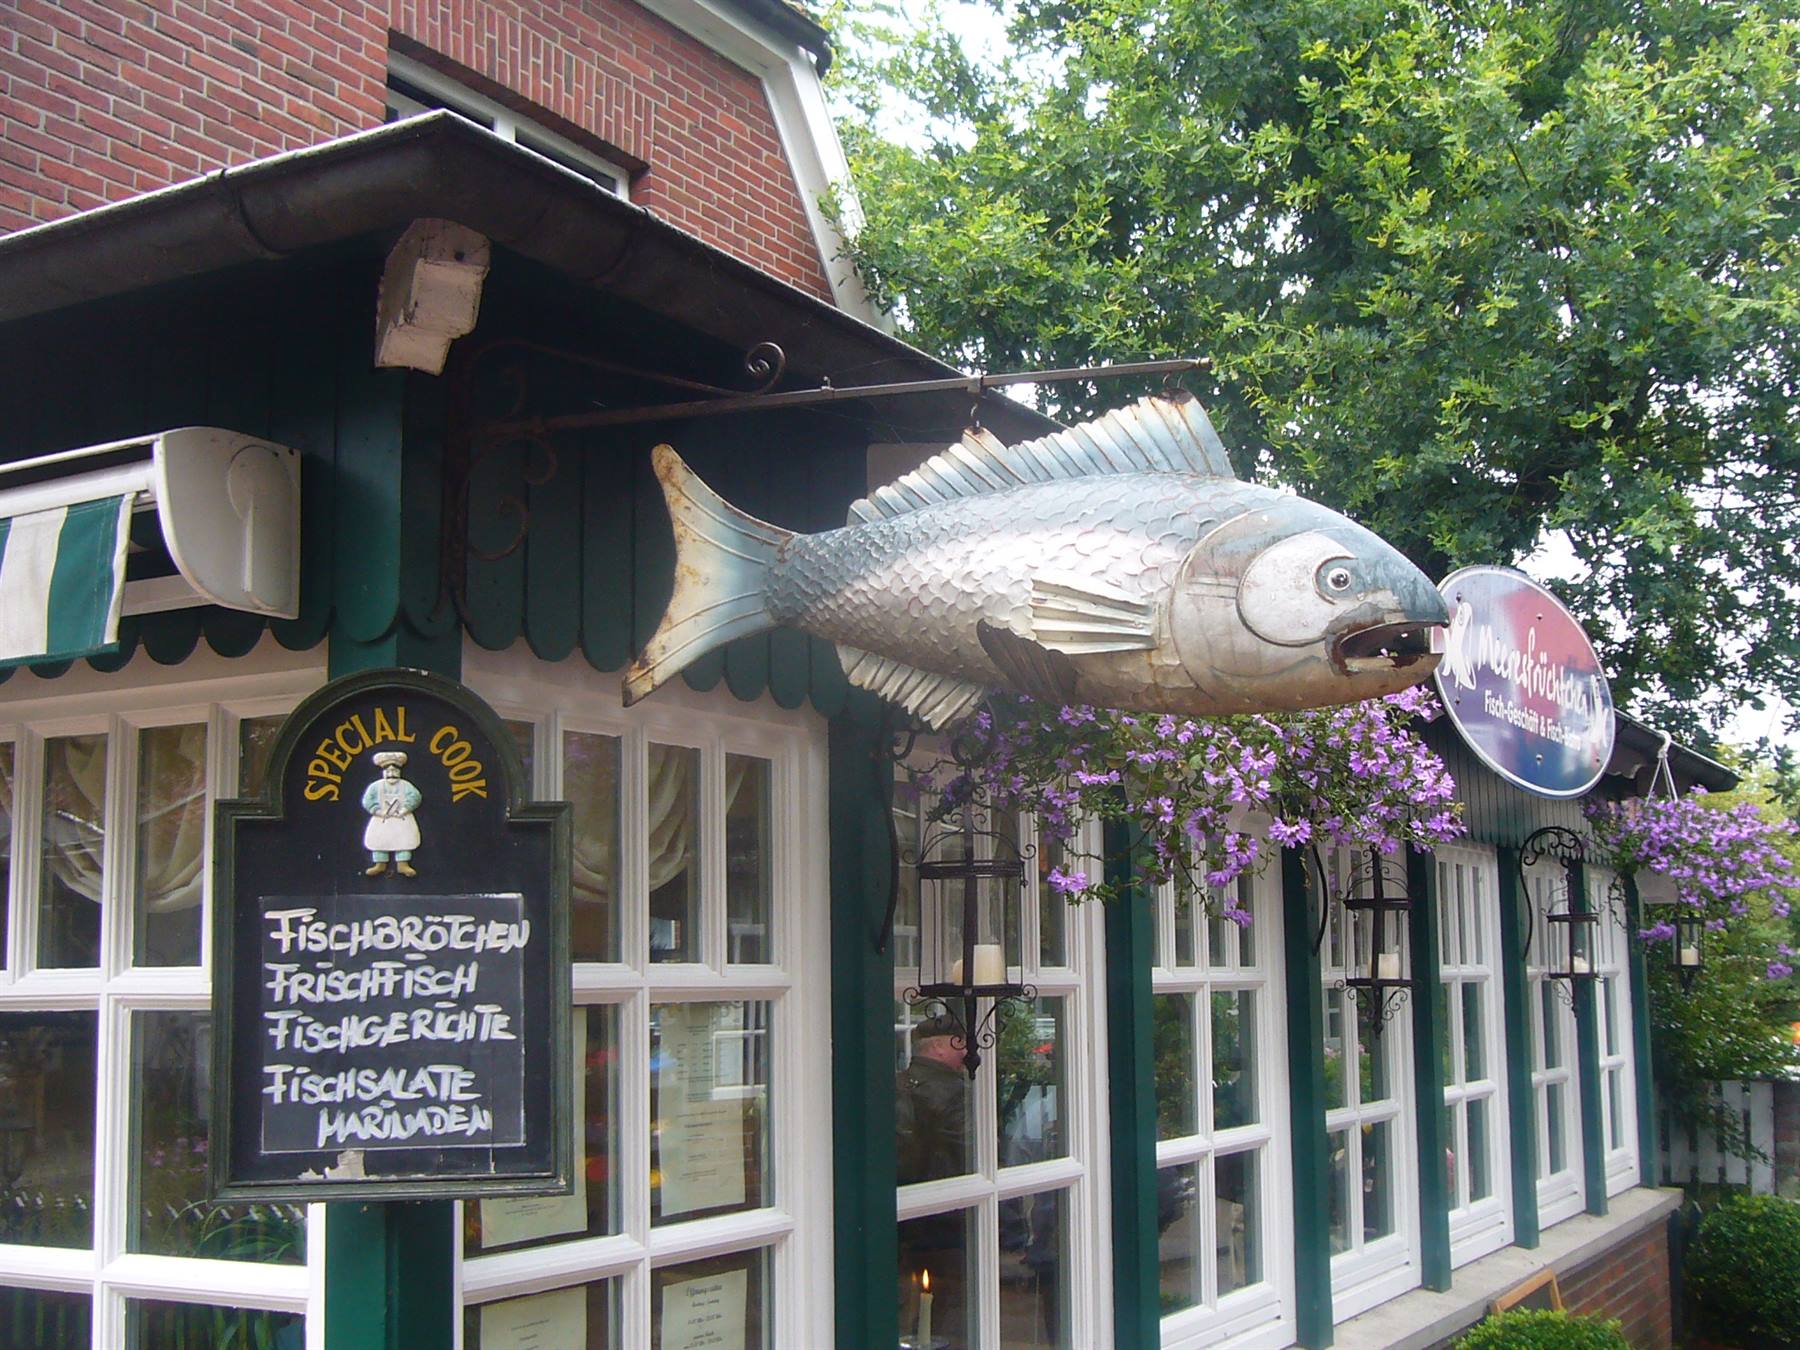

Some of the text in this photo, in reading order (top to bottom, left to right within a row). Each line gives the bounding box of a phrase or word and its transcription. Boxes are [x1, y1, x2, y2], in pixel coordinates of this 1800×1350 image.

[1484, 689, 1539, 735] Fisch-Geschäft
[1539, 714, 1546, 737] &
[304, 706, 487, 802] SPECIAL COOK
